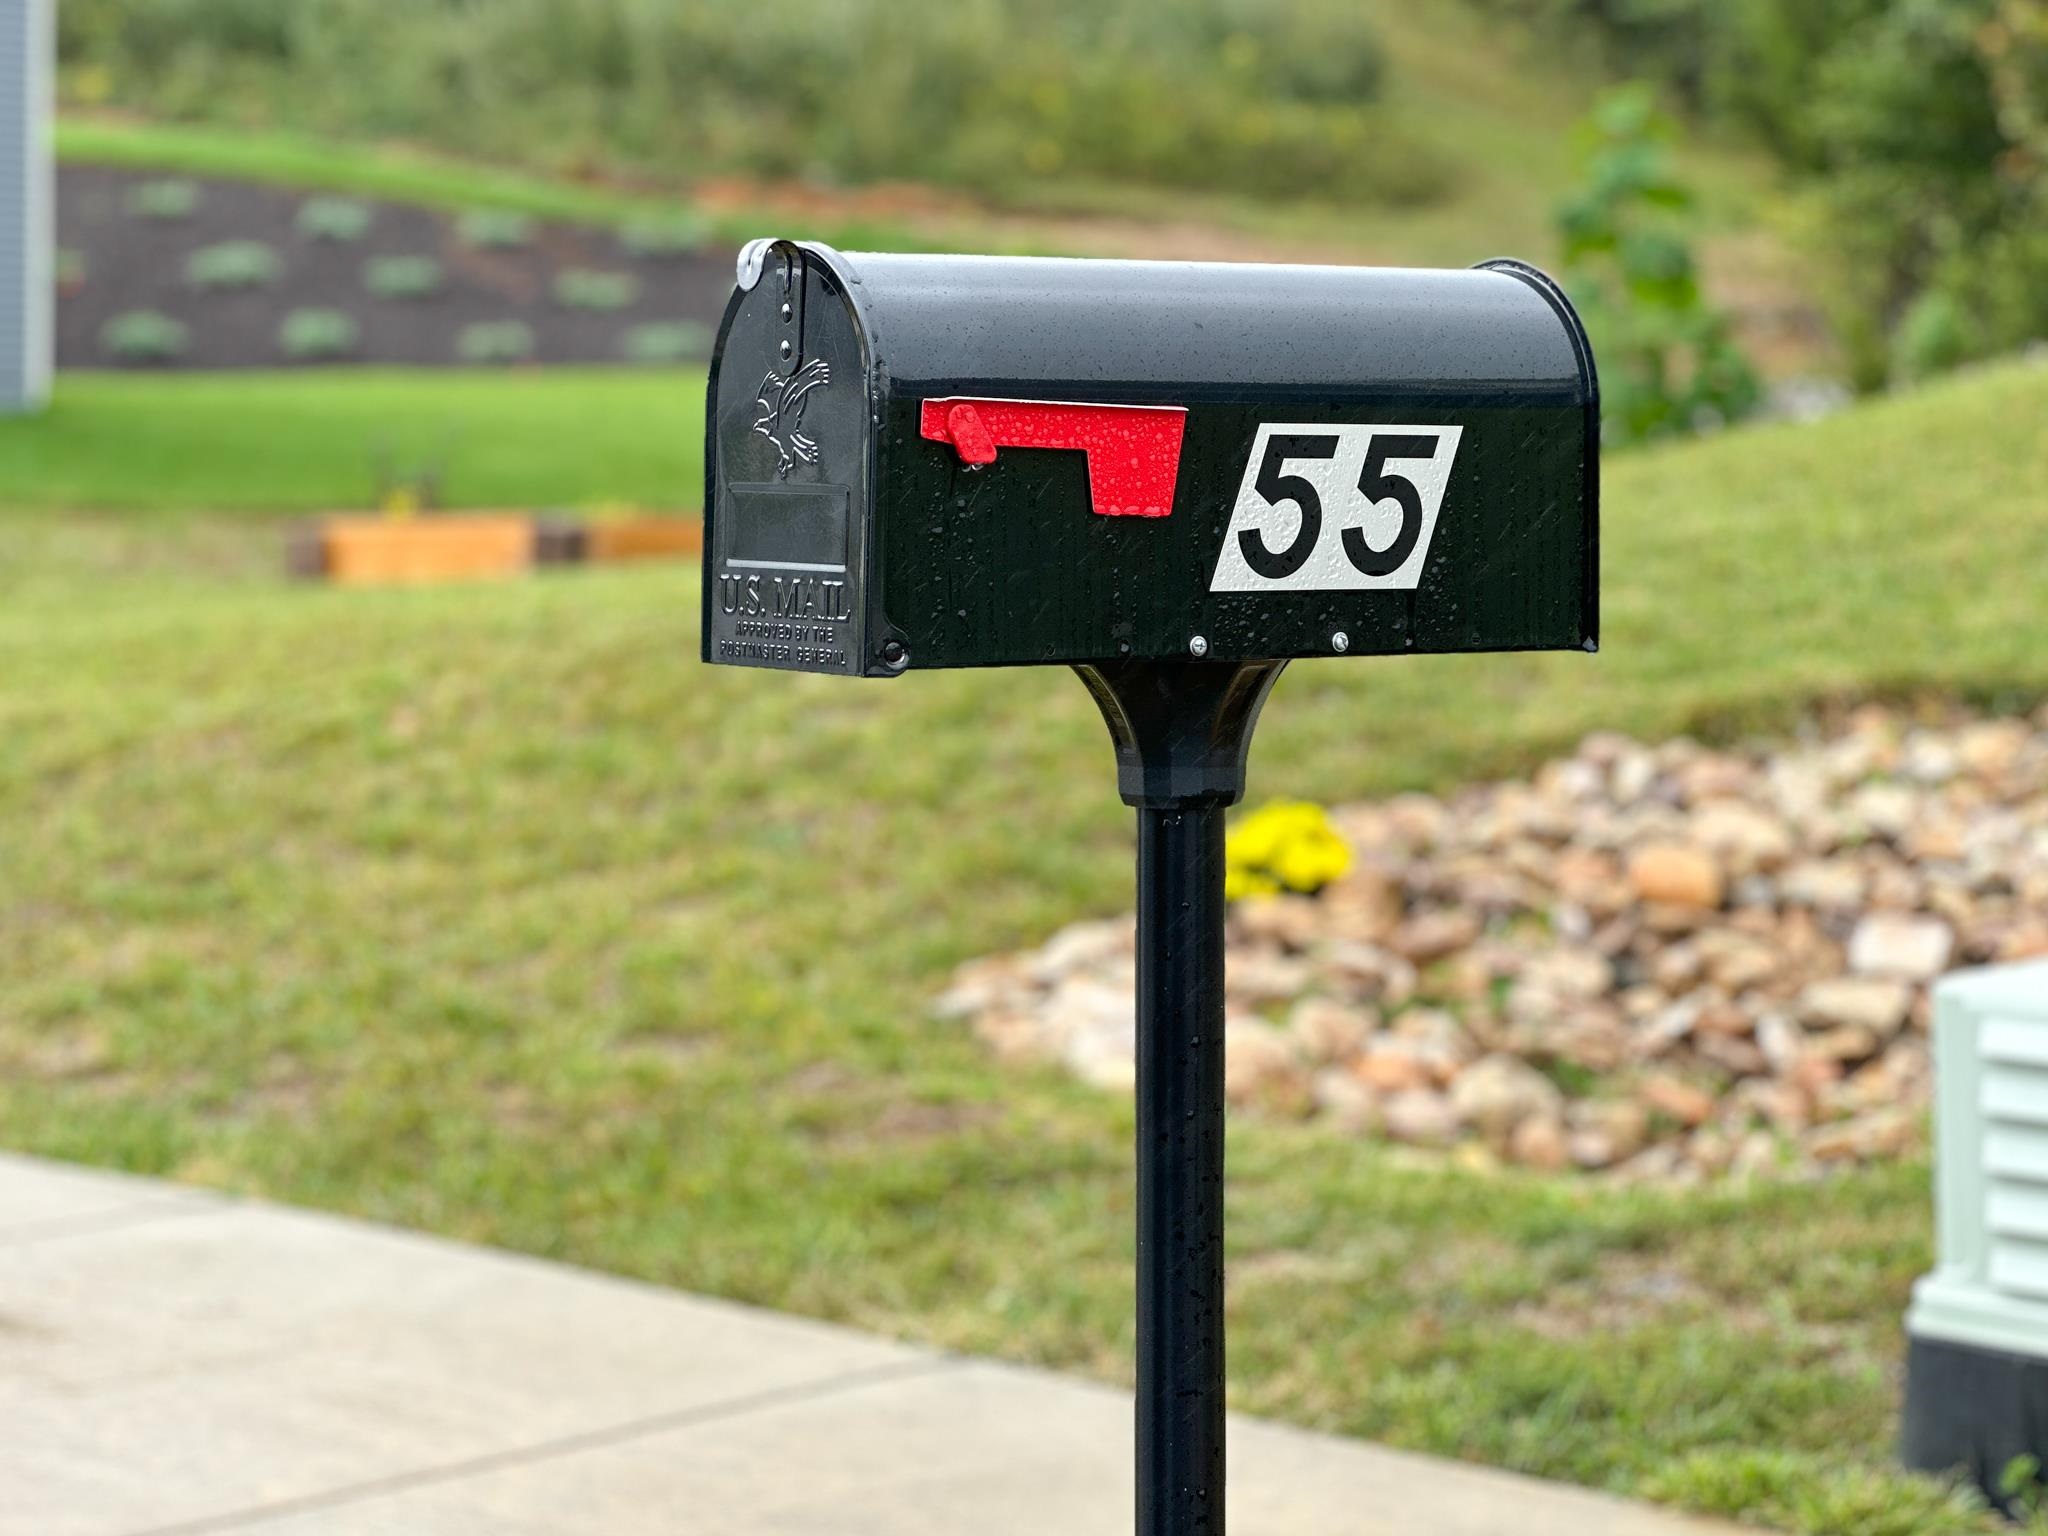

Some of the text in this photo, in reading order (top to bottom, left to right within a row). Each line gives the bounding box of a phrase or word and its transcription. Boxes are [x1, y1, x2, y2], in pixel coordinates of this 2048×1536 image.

[1238, 434, 1440, 579] 55
[720, 573, 851, 622] U.S. MAIL
[735, 620, 833, 643] APPROVED BY THE
[720, 640, 846, 666] POSTMASTER GENERAL
